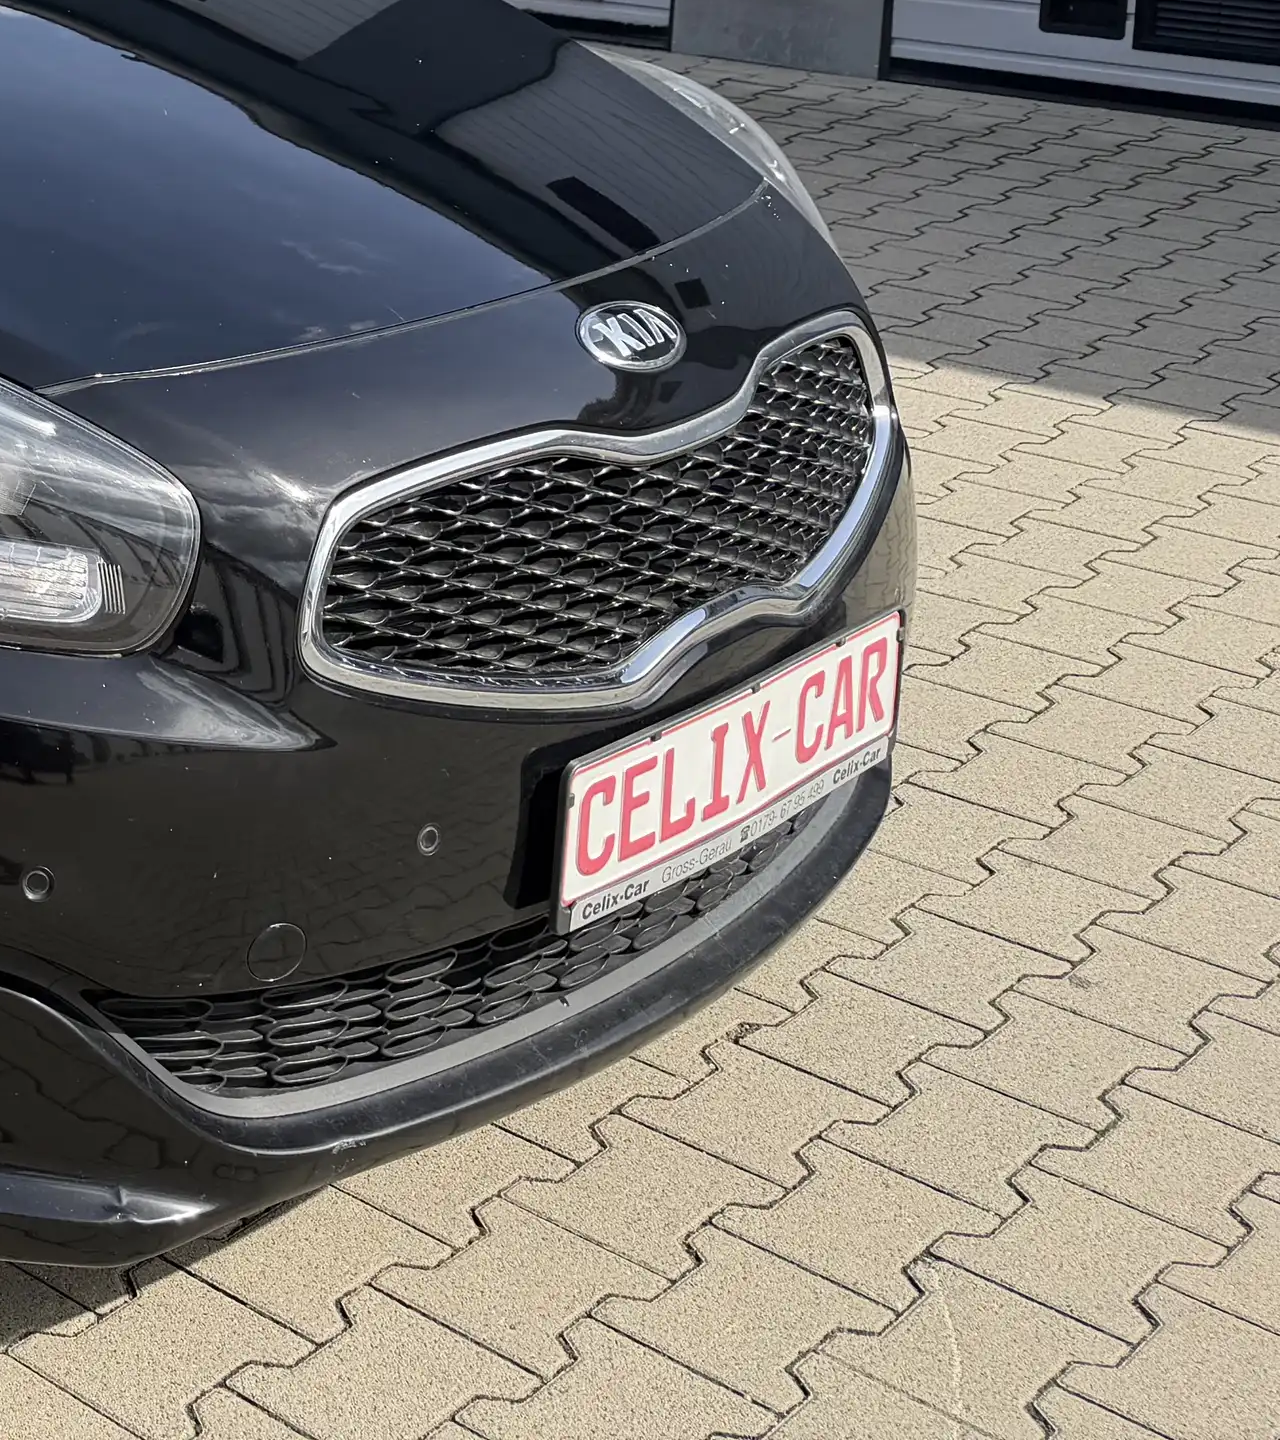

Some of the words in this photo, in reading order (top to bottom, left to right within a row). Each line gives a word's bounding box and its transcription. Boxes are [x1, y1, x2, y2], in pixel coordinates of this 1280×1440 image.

[592, 308, 677, 357] KIA
[576, 636, 888, 877] CELIX-CAR
[661, 838, 733, 884] Gross-Gerau
